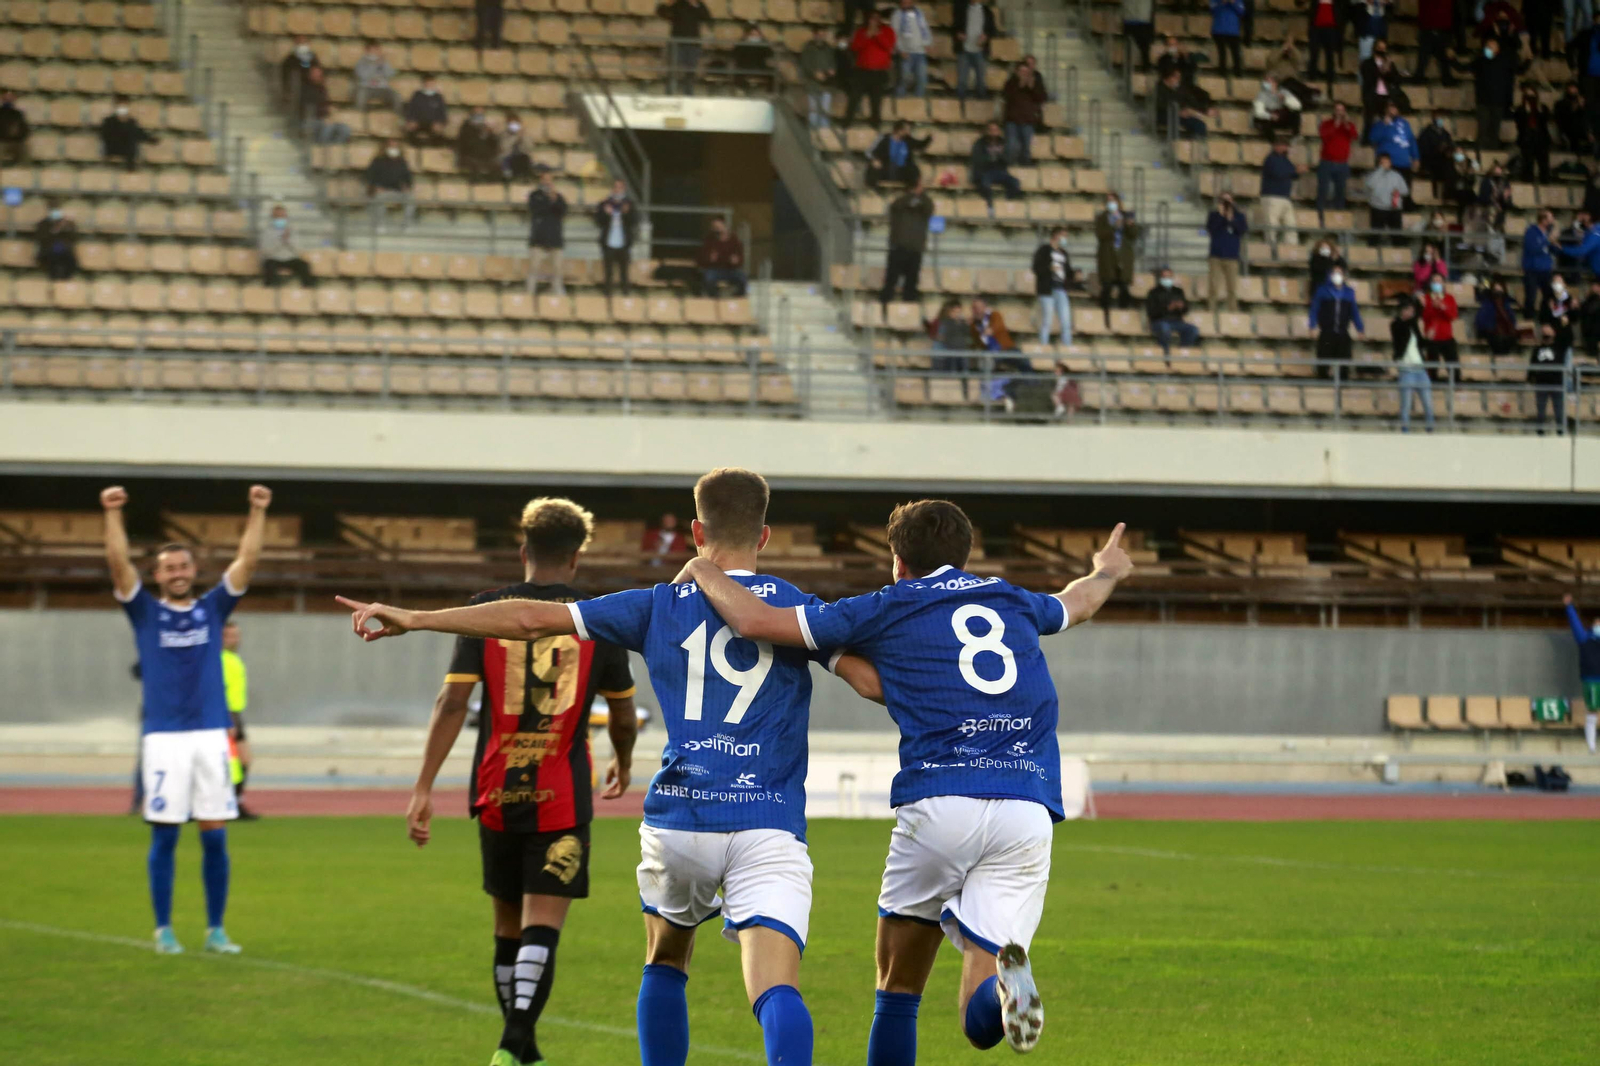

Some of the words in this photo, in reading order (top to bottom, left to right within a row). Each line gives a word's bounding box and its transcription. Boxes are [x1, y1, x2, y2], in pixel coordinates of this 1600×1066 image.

[497, 634, 580, 716] 19
[680, 619, 774, 725] 19
[951, 603, 1018, 694] 8
[154, 770, 167, 795] 7
[969, 757, 1036, 772] DEPORTIVO
[655, 783, 690, 799] XEREZ
[691, 789, 766, 803] DEPORTIVO
